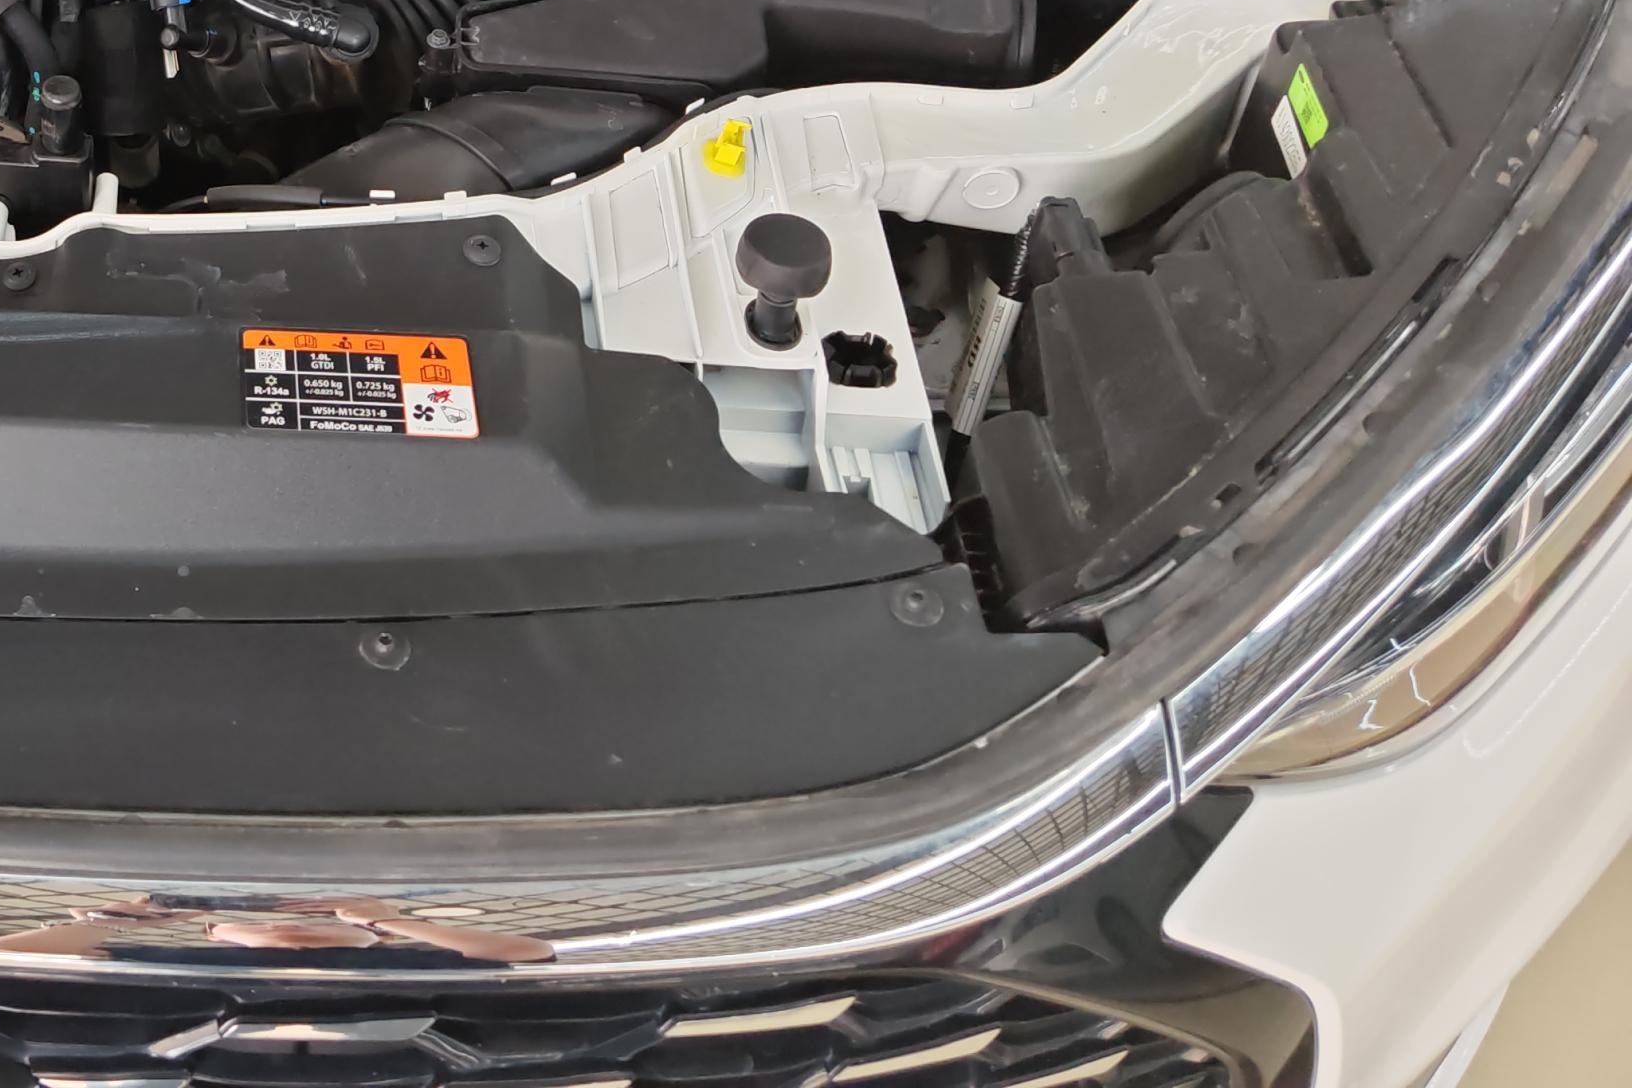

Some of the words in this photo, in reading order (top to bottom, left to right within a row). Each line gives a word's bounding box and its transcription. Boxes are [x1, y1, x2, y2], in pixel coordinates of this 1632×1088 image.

[367, 364, 385, 372] PFI
[304, 379, 330, 388] 0.650
[331, 380, 343, 389] kg
[356, 381, 382, 390] 0.725
[383, 382, 396, 392] kg
[254, 385, 290, 396] R-134a
[334, 389, 344, 397] kg
[387, 391, 397, 400] kg
[260, 415, 286, 426] PAG
[310, 420, 357, 431] FoMoCo
